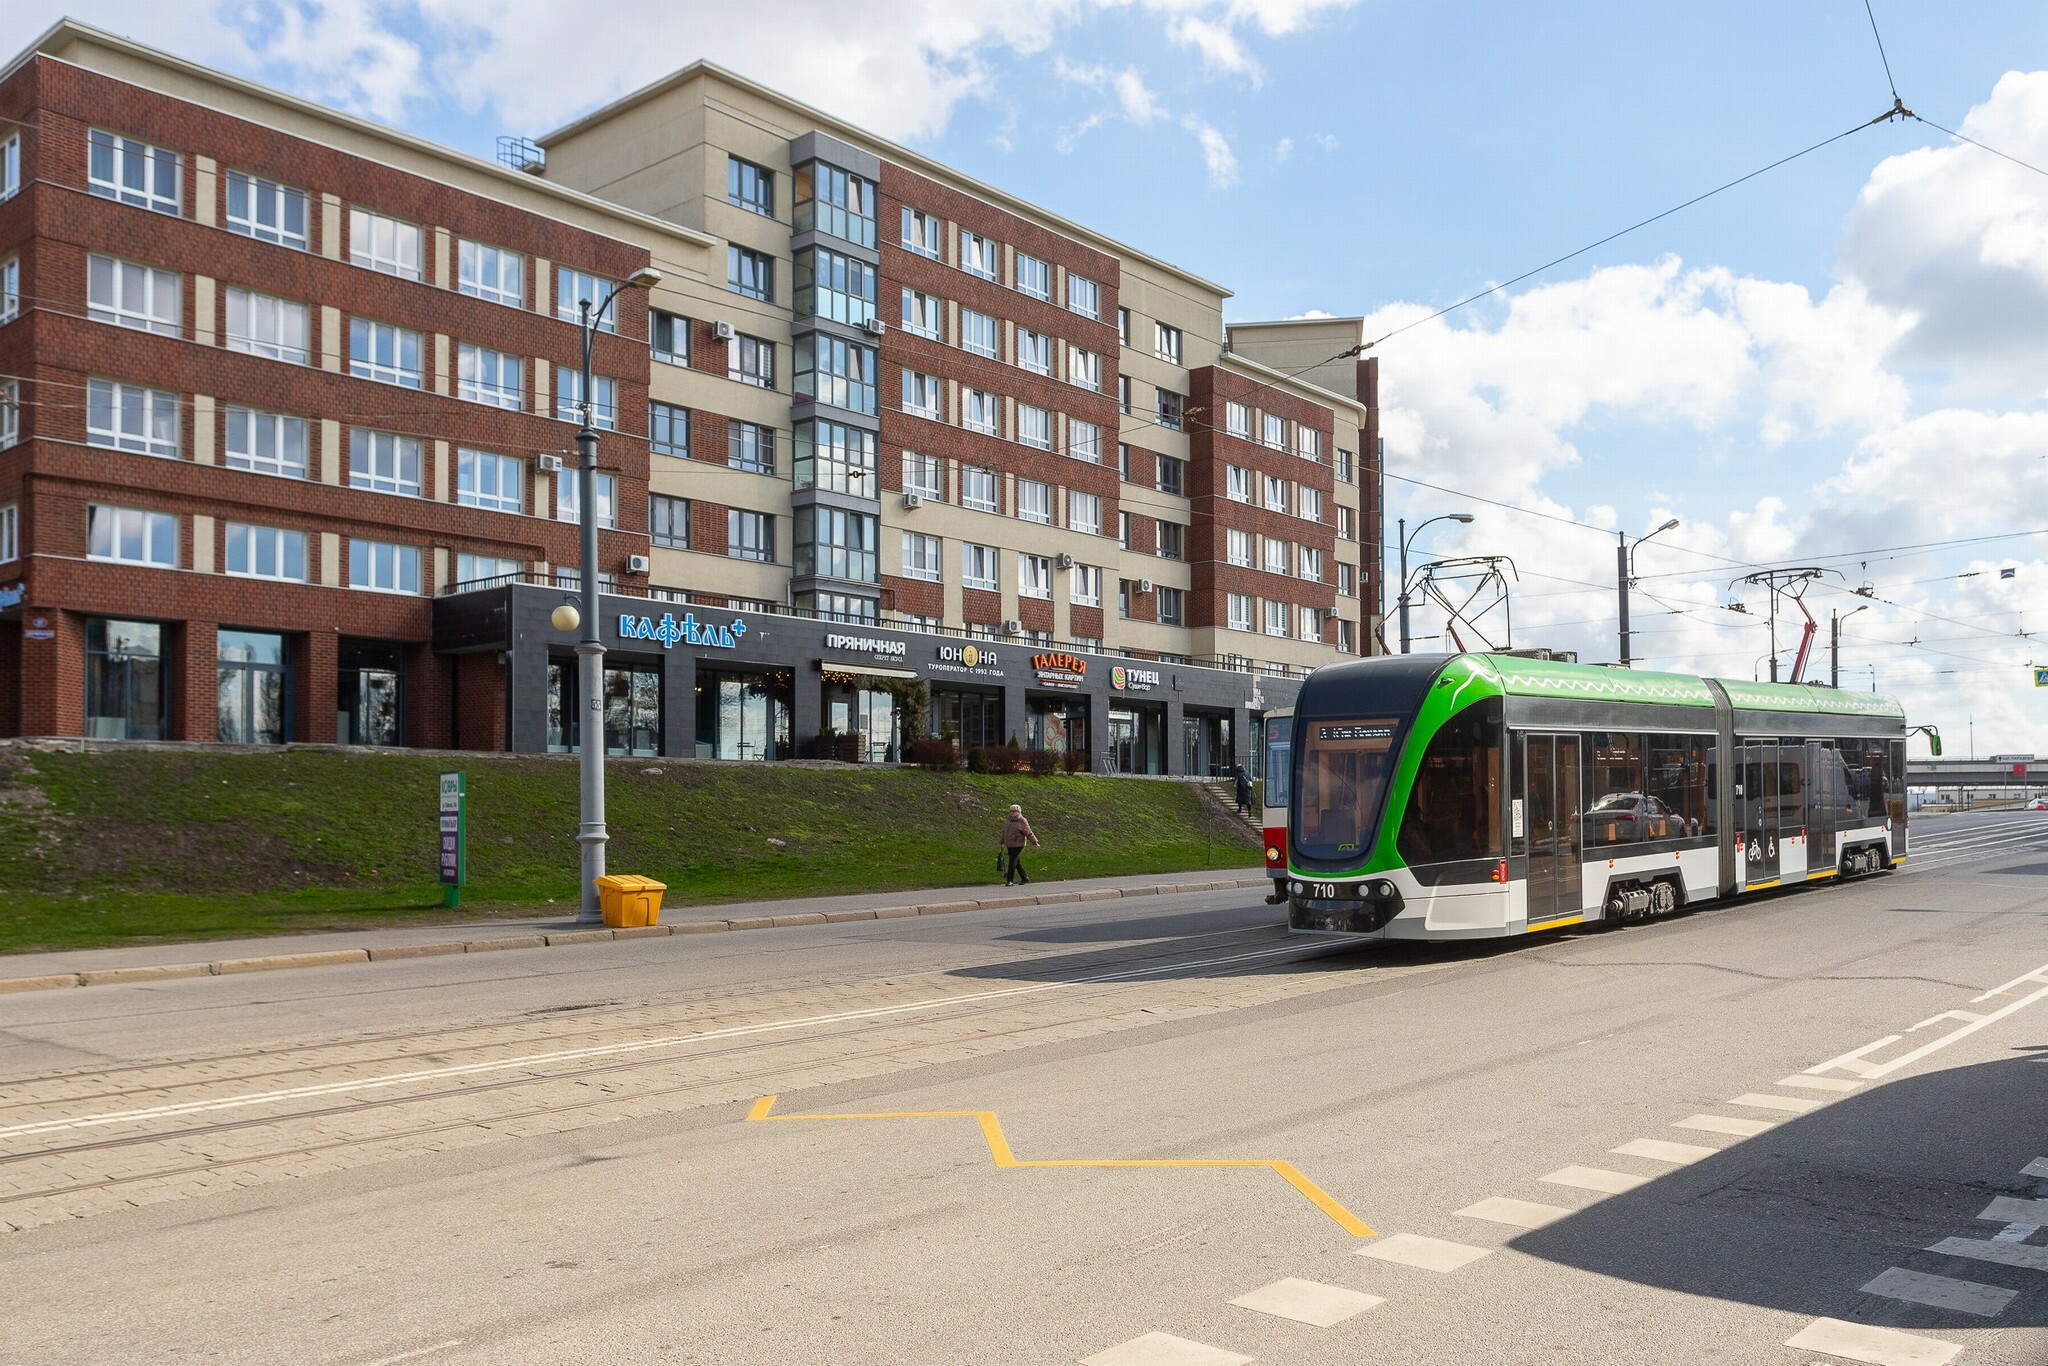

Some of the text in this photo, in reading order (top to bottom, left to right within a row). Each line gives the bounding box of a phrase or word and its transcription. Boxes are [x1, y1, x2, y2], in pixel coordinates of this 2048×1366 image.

[827, 633, 906, 656] ПРЯНИЧНАЯ
[928, 663, 967, 673] ТУРОПЕРАТОР
[989, 669, 1004, 677] ГОДА
[1033, 652, 1087, 675] ГАЛЕРЕЯ
[1126, 668, 1160, 686] ТУНЕЦ
[1313, 883, 1335, 898] 710
